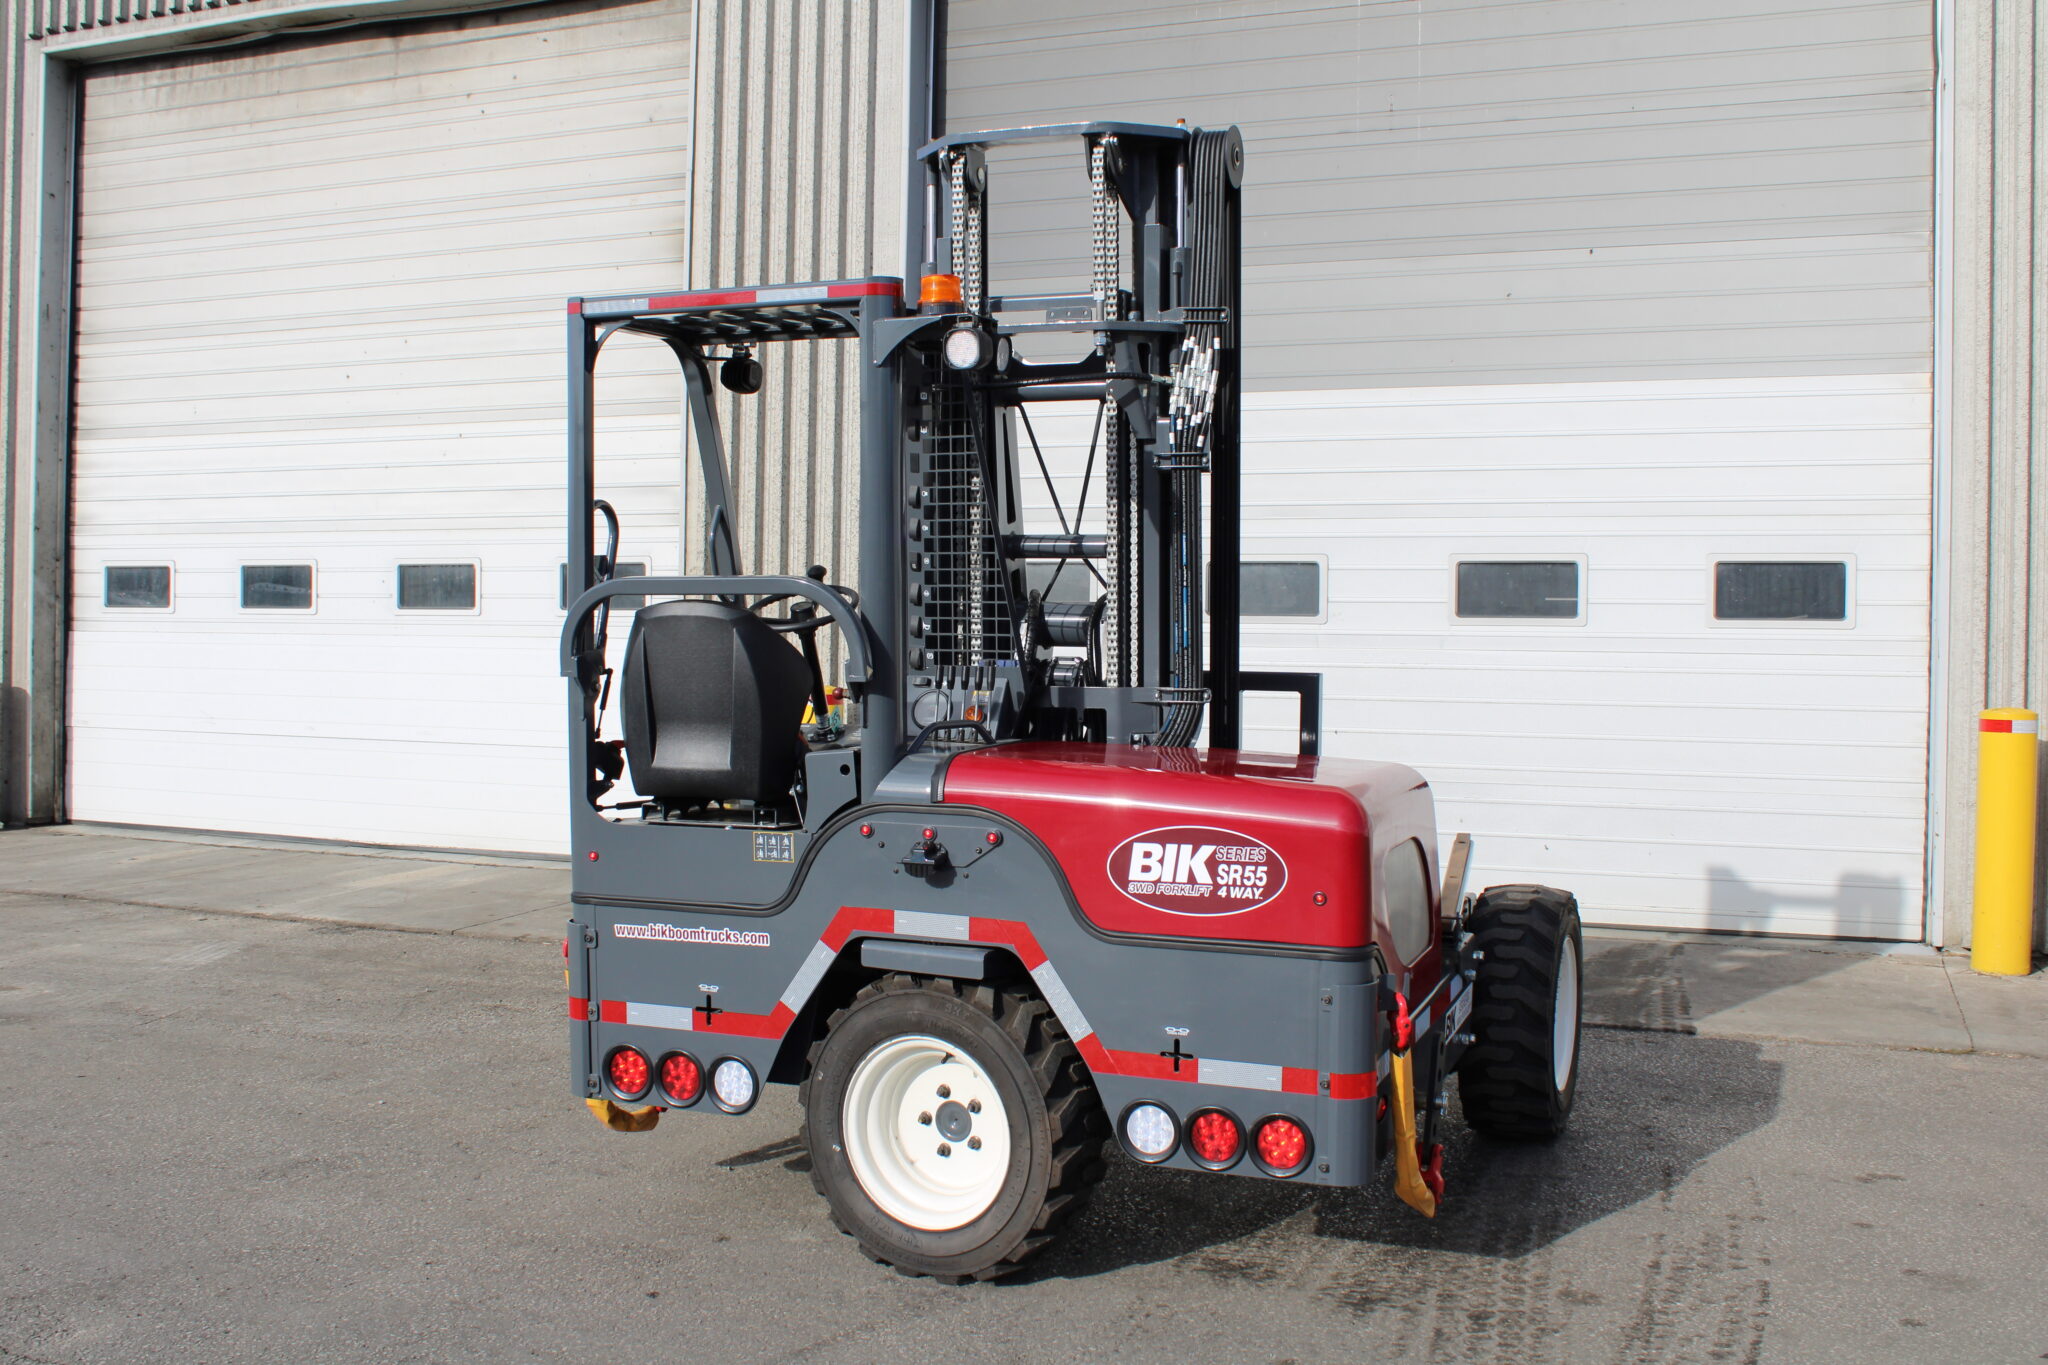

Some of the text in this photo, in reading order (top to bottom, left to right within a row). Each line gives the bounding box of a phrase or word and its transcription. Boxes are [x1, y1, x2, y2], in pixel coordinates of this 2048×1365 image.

[1128, 842, 1217, 884] BIK
[1216, 846, 1267, 862] SERIES
[1216, 864, 1268, 887] SR55
[1128, 883, 1213, 897] 3WD FORKLIFT
[1217, 886, 1227, 898] 4
[614, 923, 770, 947] www.bikboomtrucks.com
